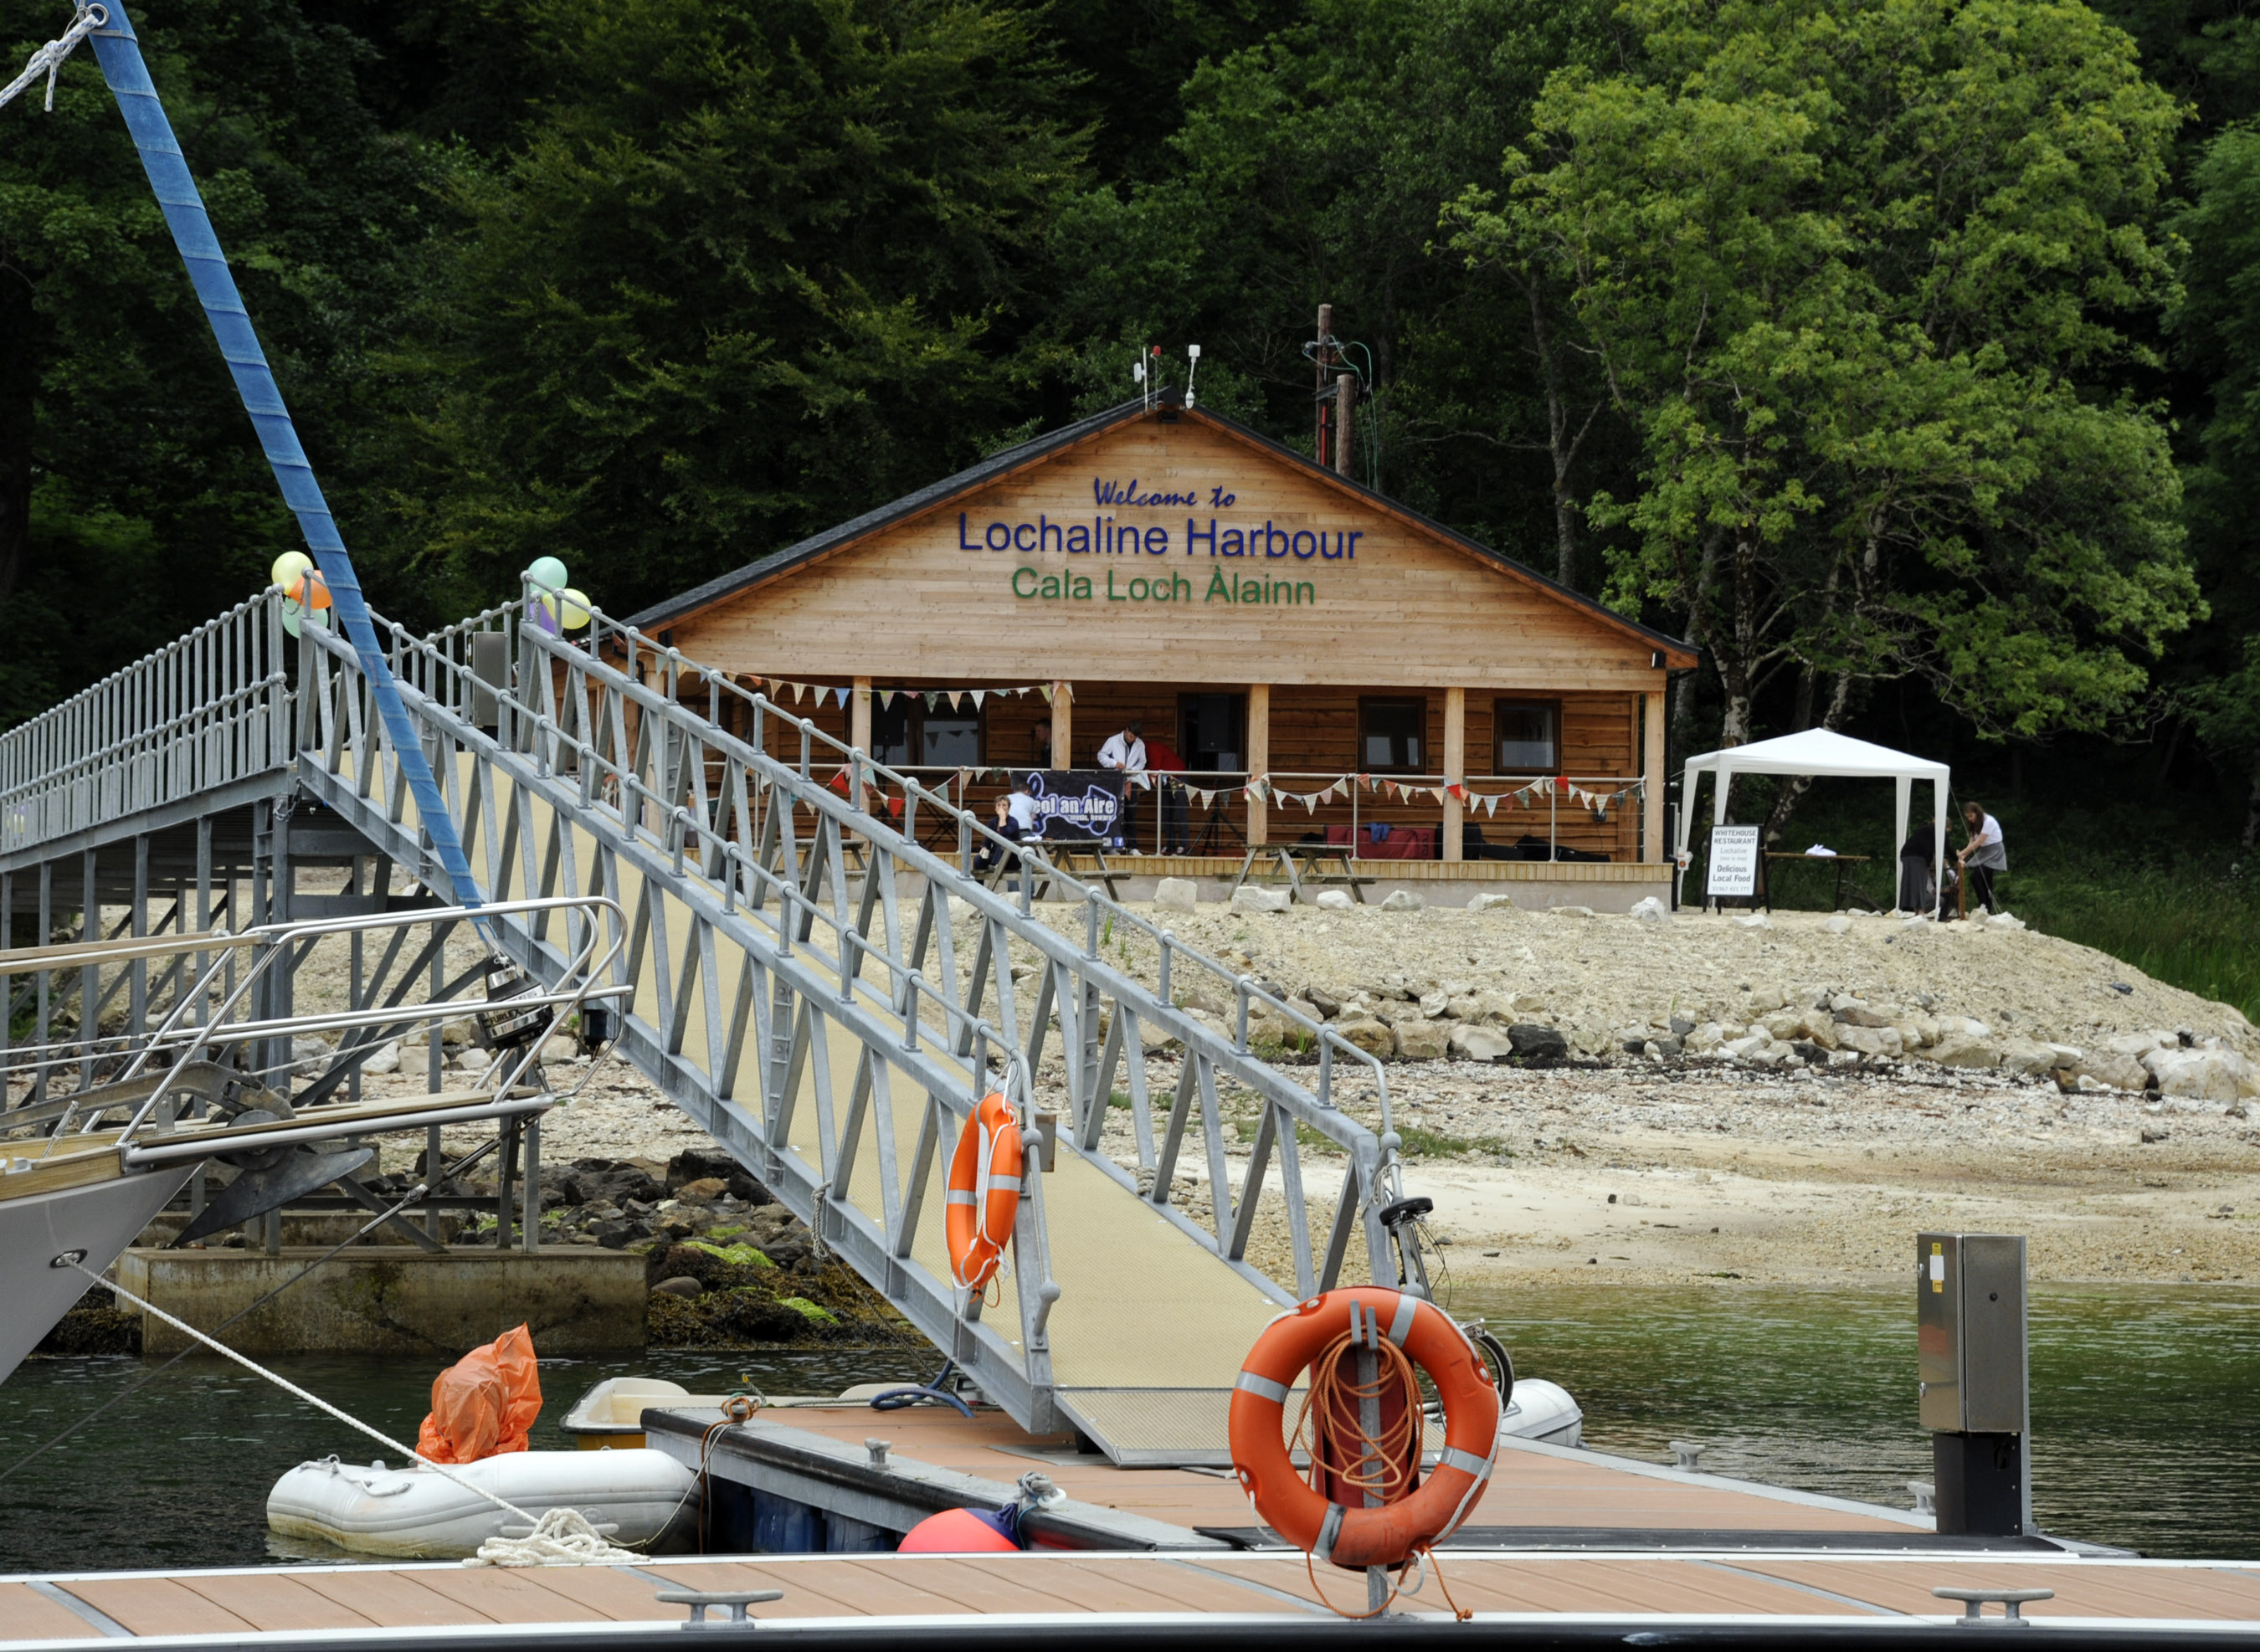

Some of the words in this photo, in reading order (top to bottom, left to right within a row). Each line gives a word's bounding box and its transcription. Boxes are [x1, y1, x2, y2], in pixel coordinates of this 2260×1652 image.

[1094, 477, 1197, 506] Welcome
[1210, 485, 1236, 508] to
[959, 512, 1169, 554] Lochaline
[1187, 517, 1364, 560] Harbour
[1012, 567, 1092, 600] Cala
[1107, 569, 1192, 603] Loch
[1204, 565, 1316, 605] Àlainn
[1035, 797, 1056, 814] eol
[1060, 799, 1080, 814] an
[1083, 797, 1115, 814] Aire
[1717, 864, 1747, 873] Delicious
[490, 1008, 523, 1024] FURLEX
